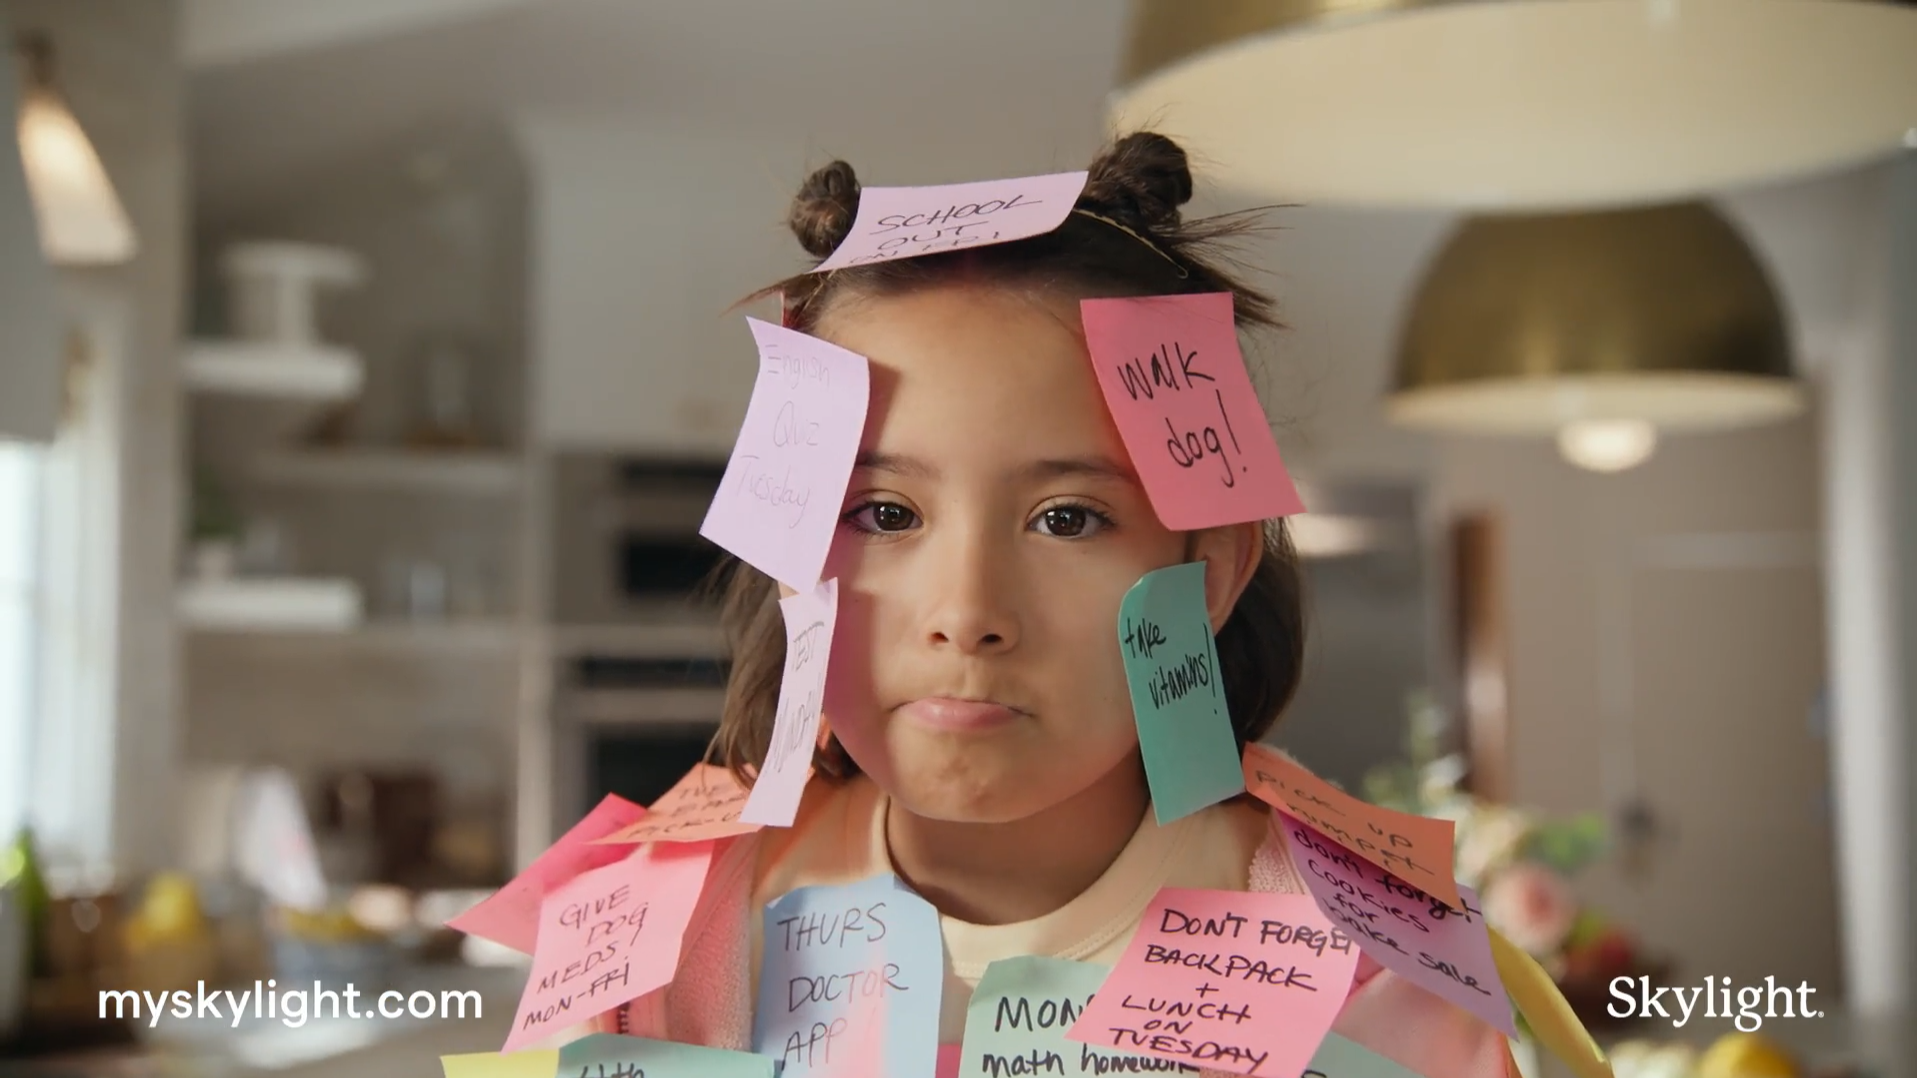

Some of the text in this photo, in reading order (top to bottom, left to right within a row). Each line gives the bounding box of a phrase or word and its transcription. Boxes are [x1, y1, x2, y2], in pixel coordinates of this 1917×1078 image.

[868, 194, 1044, 236] SCHOOL
[877, 220, 990, 250] OUT
[764, 343, 830, 390] English
[1165, 388, 1248, 489] dog!
[735, 454, 811, 530] Tuesday
[1124, 617, 1167, 660] take
[1148, 622, 1218, 716] vitamins!
[558, 883, 630, 930] GIVE
[777, 902, 887, 951] THURS
[1159, 908, 1249, 939] DON'T
[1332, 892, 1381, 924] for
[788, 963, 910, 1014] DOCTOR
[1144, 943, 1318, 993] BACKPACK
[994, 993, 1096, 1033] MON
[1121, 994, 1252, 1026] LUNCH
[1143, 1019, 1194, 1035] ON
[781, 1016, 849, 1072] APP
[982, 1048, 1065, 1078] math
[1108, 1027, 1269, 1076] TUESDAY
